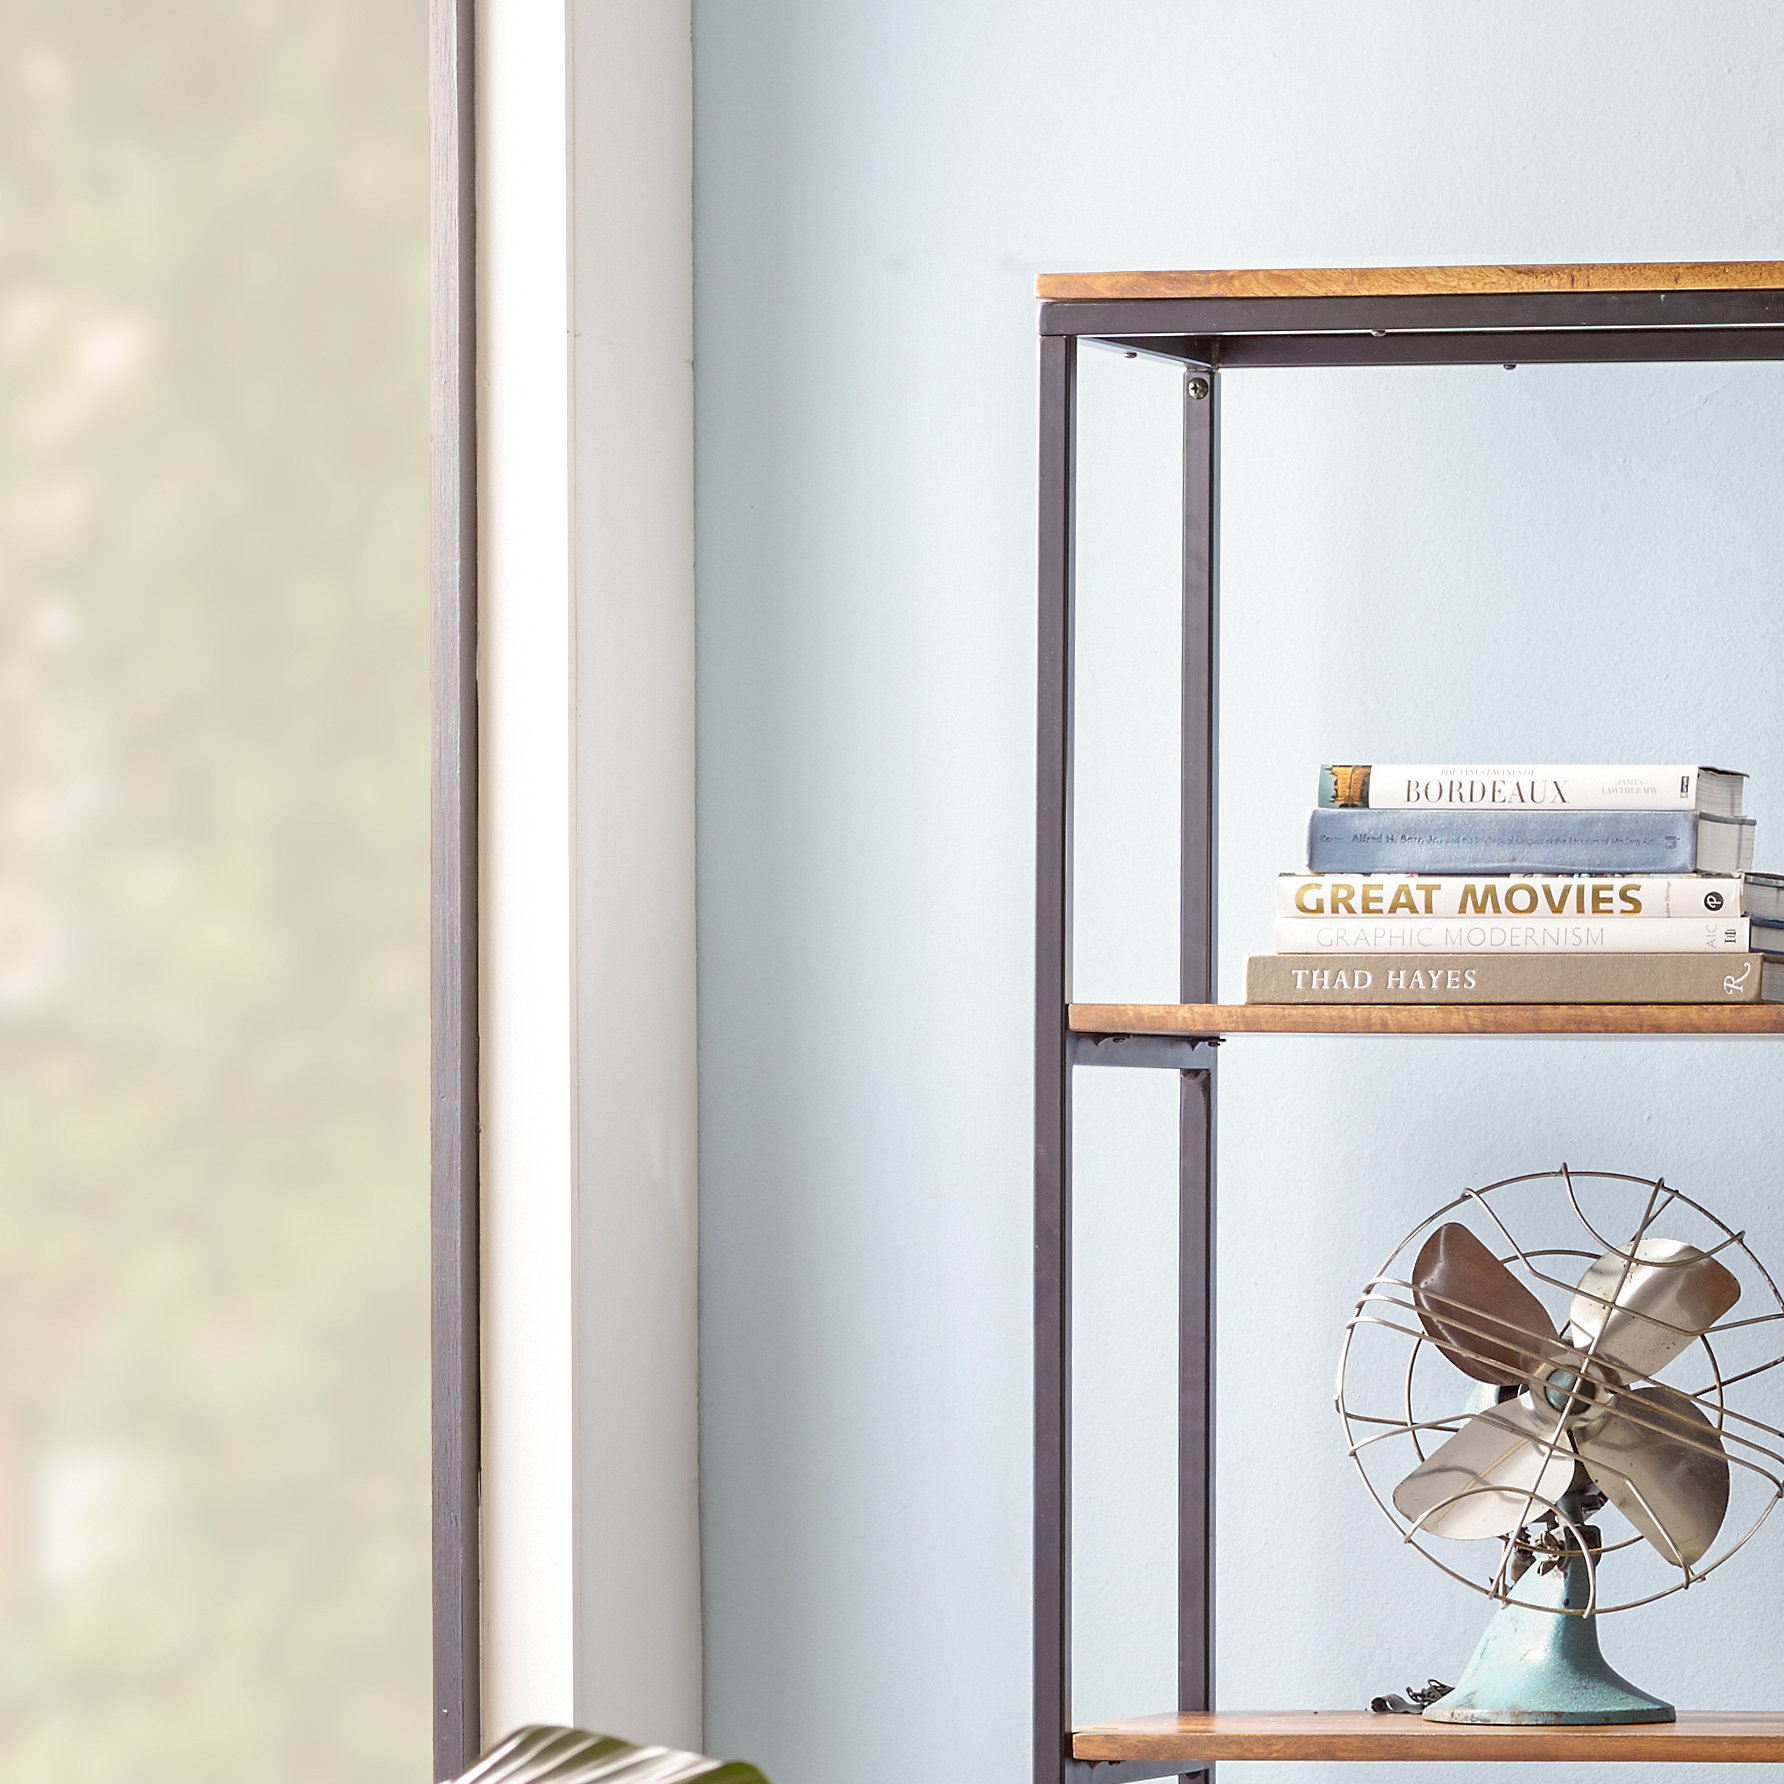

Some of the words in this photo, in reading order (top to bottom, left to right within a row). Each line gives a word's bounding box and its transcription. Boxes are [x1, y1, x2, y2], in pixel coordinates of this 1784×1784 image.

[1405, 780, 1569, 804] BORDEAUX
[1294, 883, 1442, 915] GREAT
[1458, 883, 1643, 915] MOVIES
[1316, 927, 1433, 947] GRAPHIC
[1445, 926, 1605, 947] MODERNISM
[1291, 969, 1373, 990] THAD
[1386, 969, 1477, 990] HAYES
